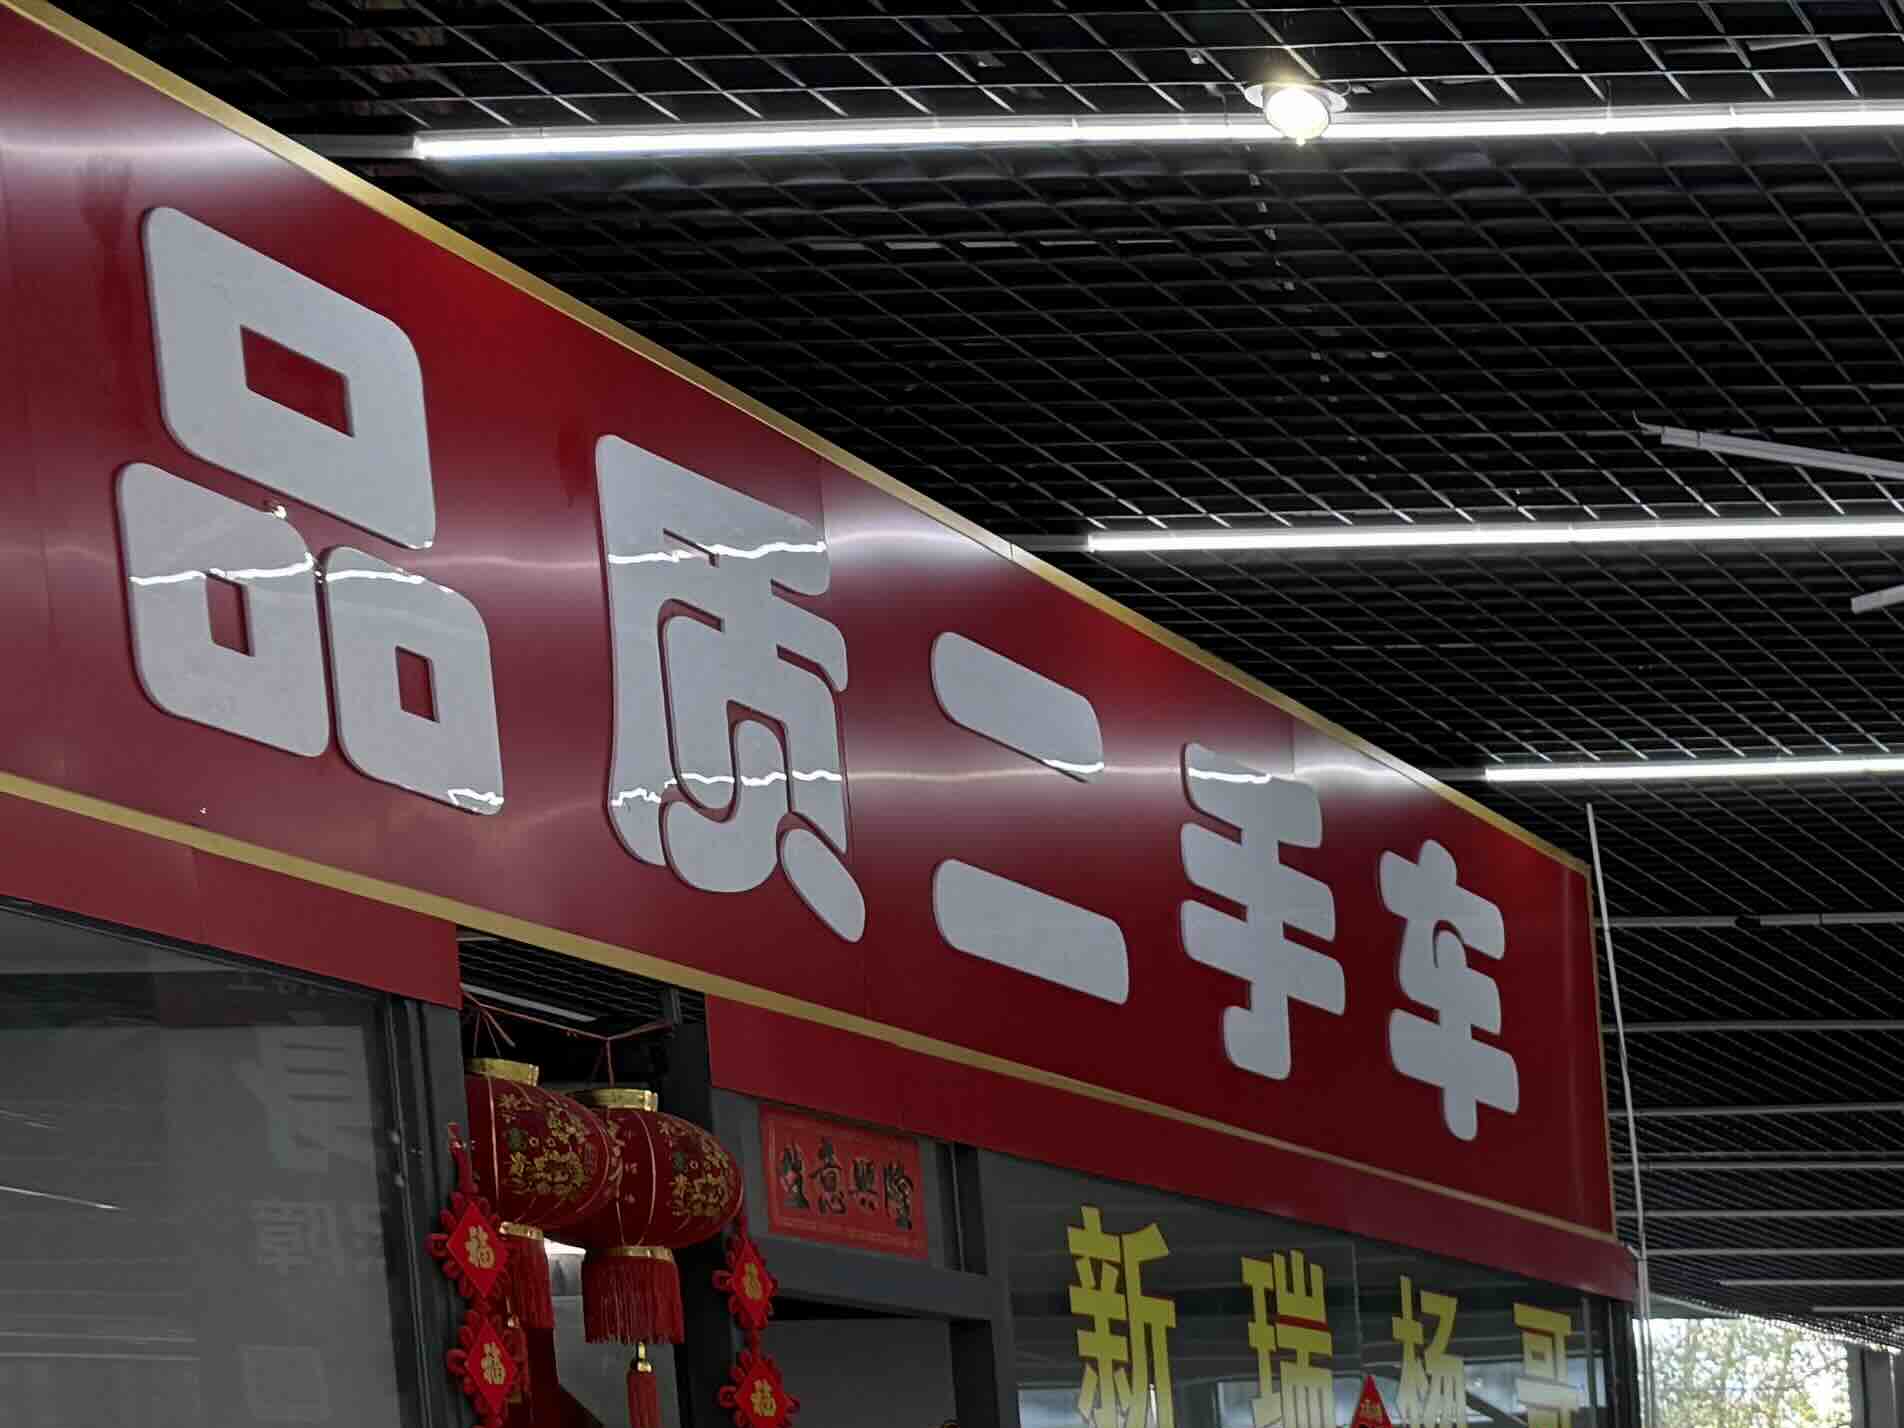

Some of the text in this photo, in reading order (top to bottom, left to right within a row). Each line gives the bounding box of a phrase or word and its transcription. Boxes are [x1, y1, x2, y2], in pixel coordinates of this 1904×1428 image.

[114, 204, 1520, 1143] 品质二手车
